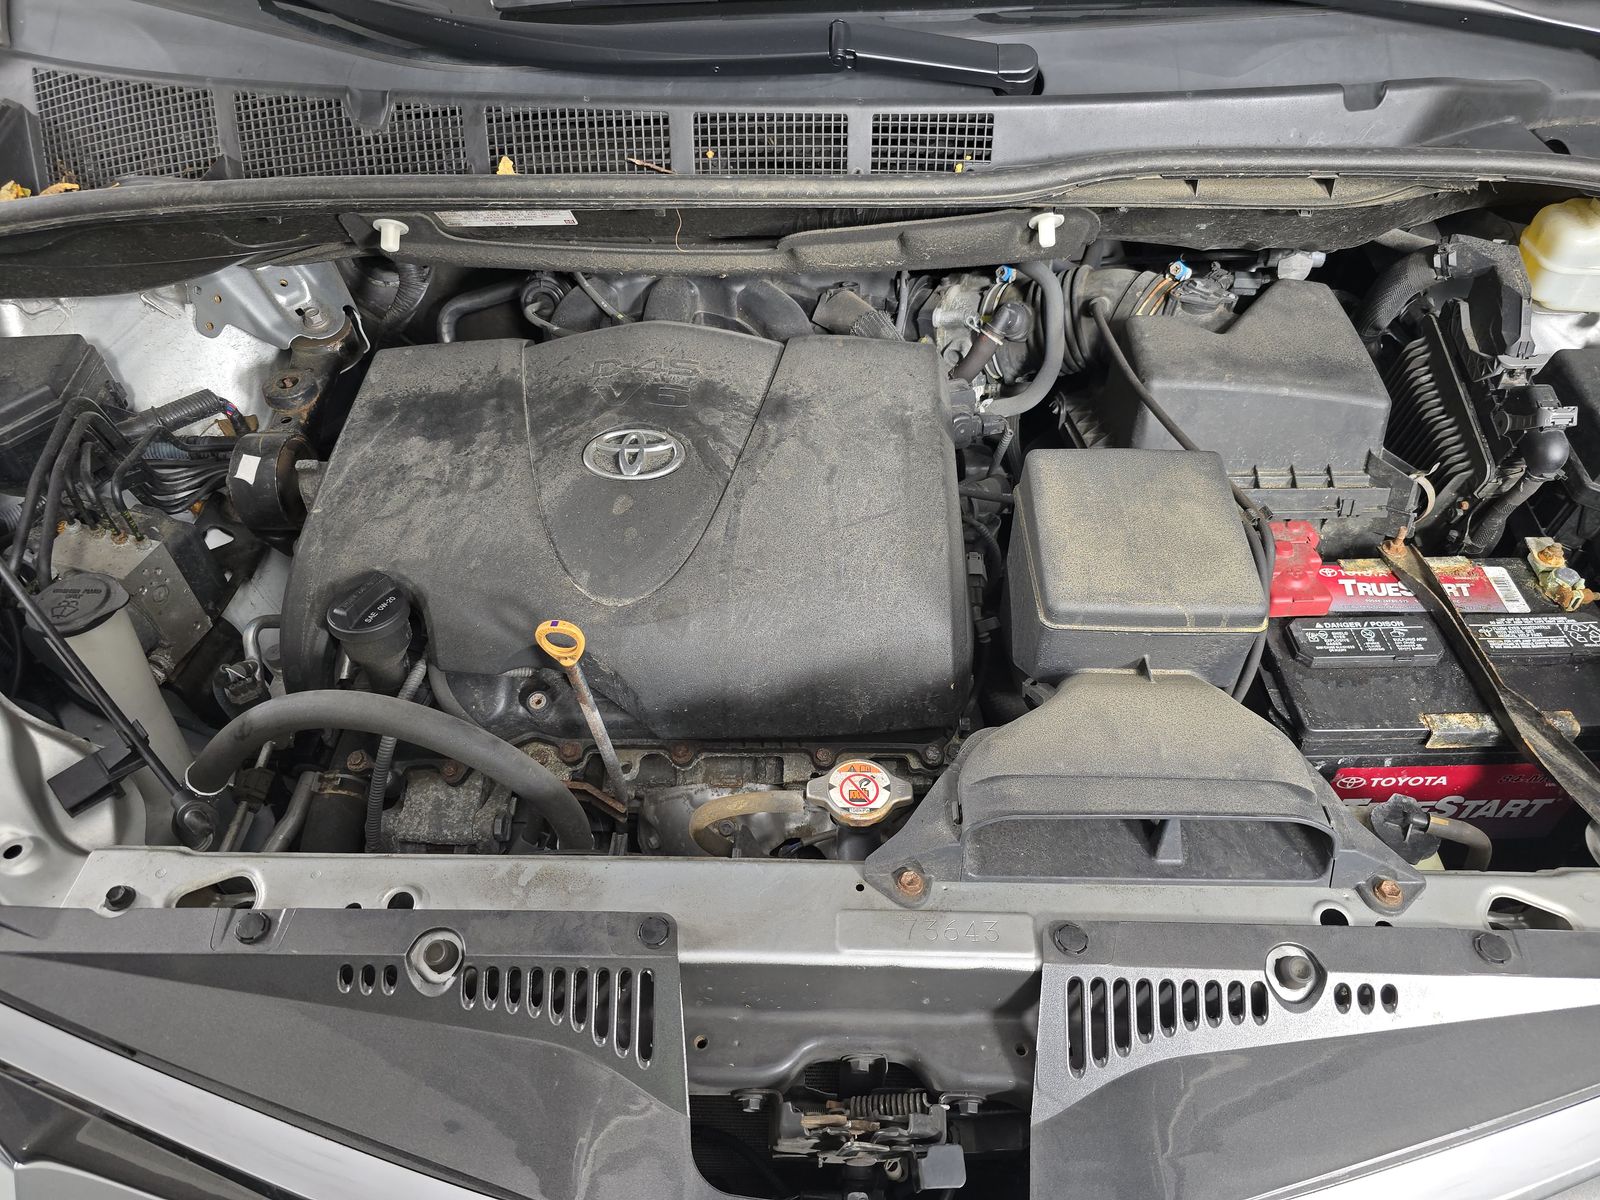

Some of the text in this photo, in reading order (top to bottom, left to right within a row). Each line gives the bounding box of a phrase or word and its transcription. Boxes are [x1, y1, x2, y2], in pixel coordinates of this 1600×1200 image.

[1338, 579, 1471, 597] TRUESRT
[364, 611, 379, 624] SAE
[1370, 776, 1447, 787] TOYOTA
[902, 918, 1000, 942] 73643
